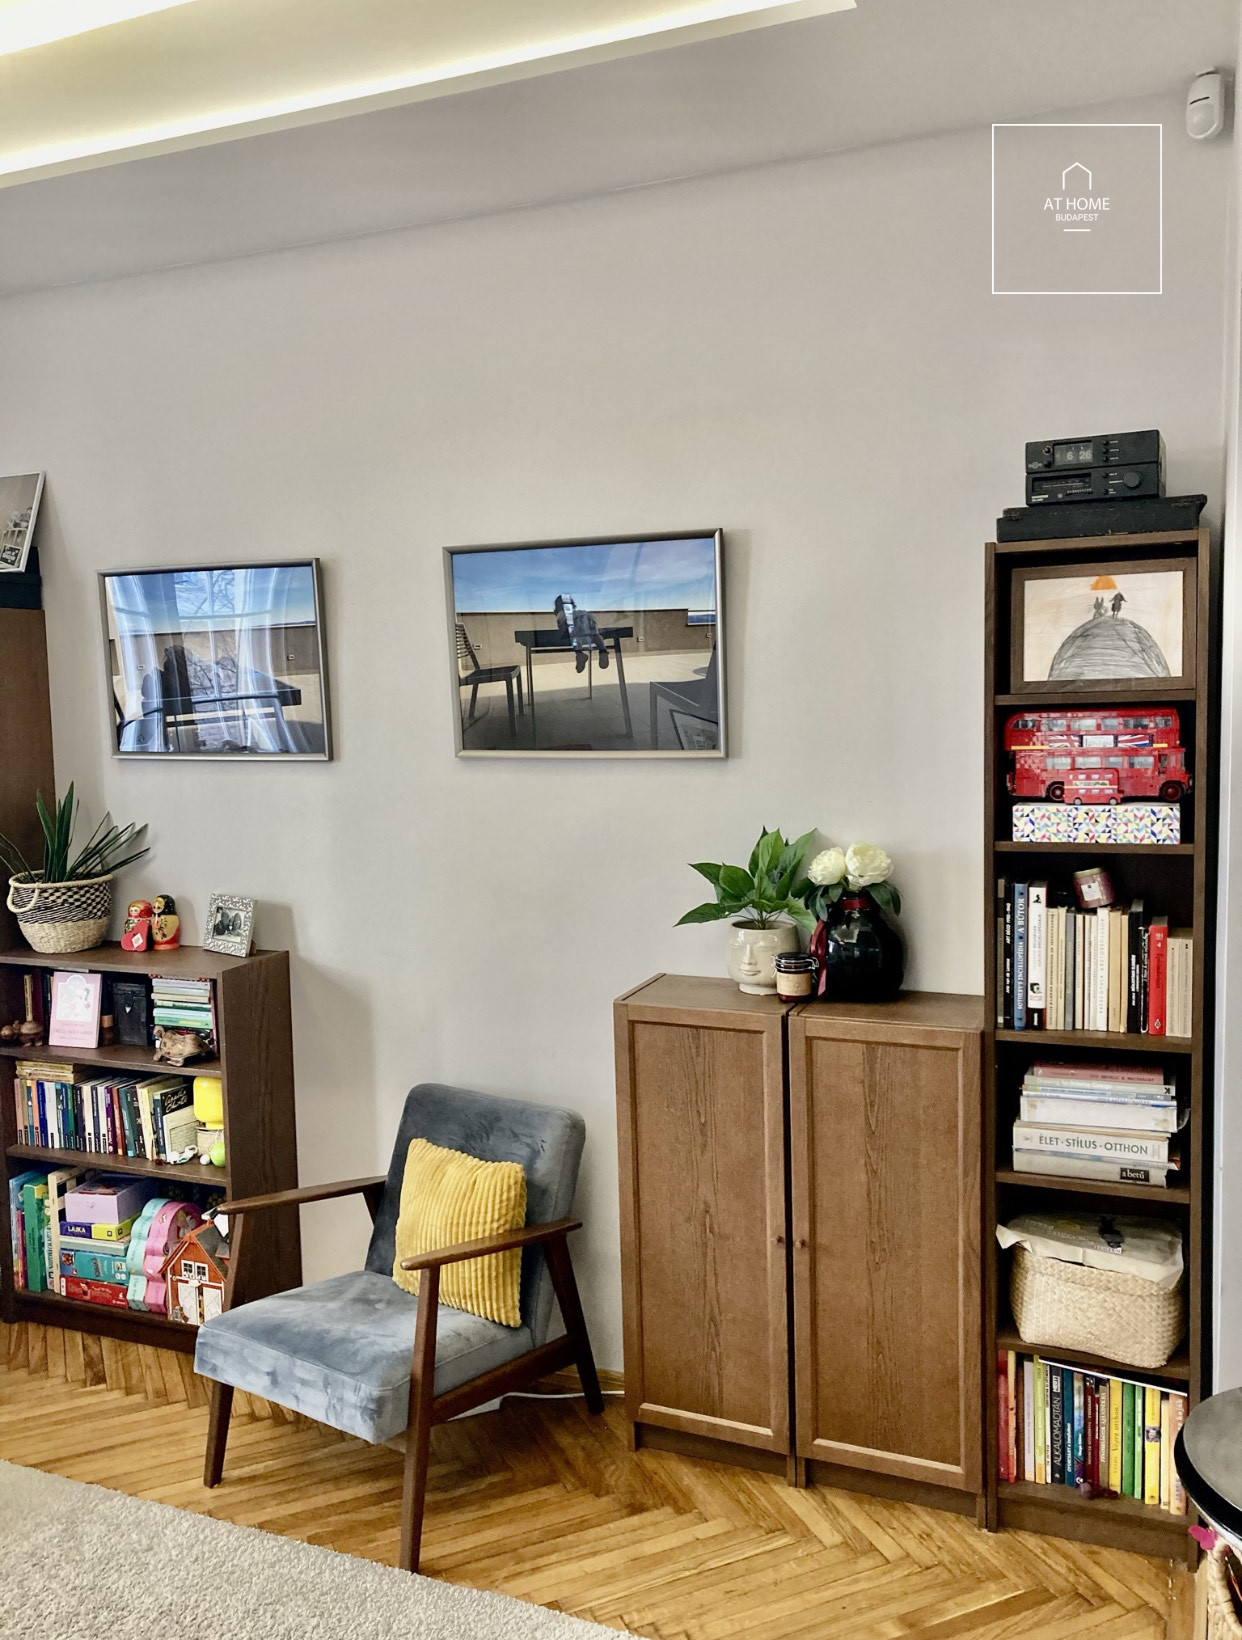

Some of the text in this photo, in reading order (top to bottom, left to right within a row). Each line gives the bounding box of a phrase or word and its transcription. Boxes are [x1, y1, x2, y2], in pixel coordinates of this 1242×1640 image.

[1066, 450, 1092, 460] 6 26
[1015, 898, 1026, 926] BÚTOR
[1039, 1133, 1148, 1155] ÉLET STÍLUS OTTHON
[1127, 1169, 1145, 1179] betű
[1052, 1396, 1062, 1466] ALKALOMADTÁN
